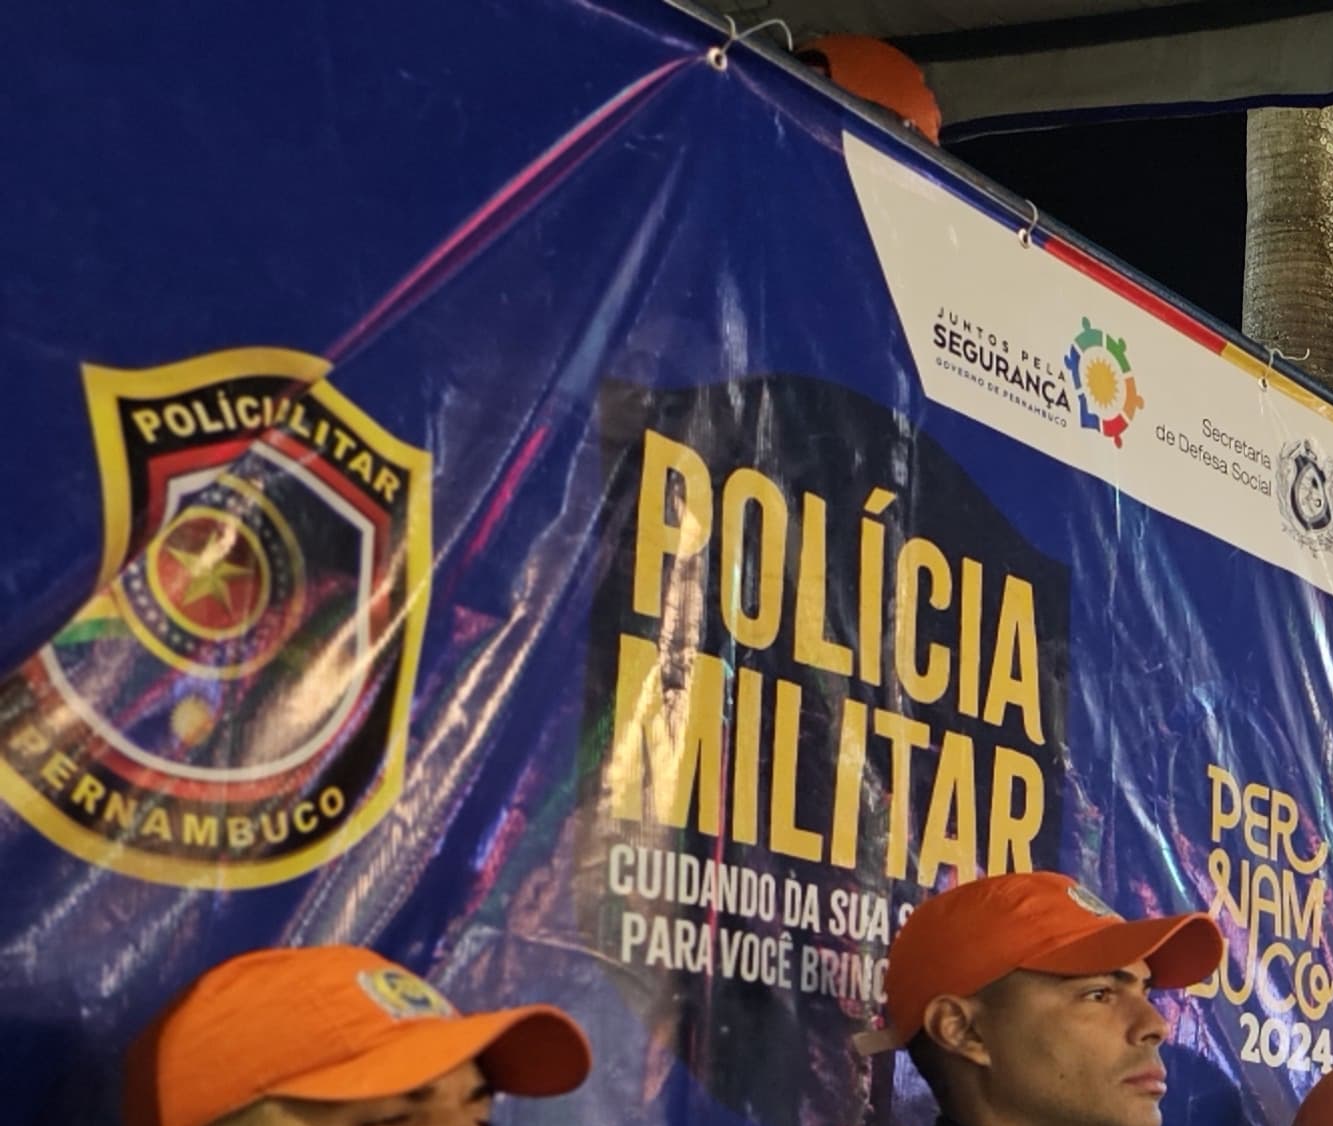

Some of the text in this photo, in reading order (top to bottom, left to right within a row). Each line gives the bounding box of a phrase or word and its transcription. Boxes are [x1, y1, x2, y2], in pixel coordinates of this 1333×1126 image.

[933, 323, 1072, 413] SEGURANÇA
[937, 306, 1067, 382] JUNTOS PELA
[936, 357, 1067, 429] GOVERNO DE PERNAMBUCO
[1155, 424, 1272, 496] de Defesa Social
[1202, 418, 1271, 470] Secretaria
[633, 428, 1046, 745] POLÍCIA
[10, 725, 346, 848] PERNAMBUCO
[602, 633, 1045, 890] MILITAR
[1207, 763, 1328, 875] PER
[609, 844, 775, 922] CUIDANDO
[783, 876, 820, 933] DA
[829, 889, 890, 945] SUA
[1207, 848, 1326, 949] NAM
[621, 912, 713, 977] PARA
[720, 930, 793, 989] VOCÊ
